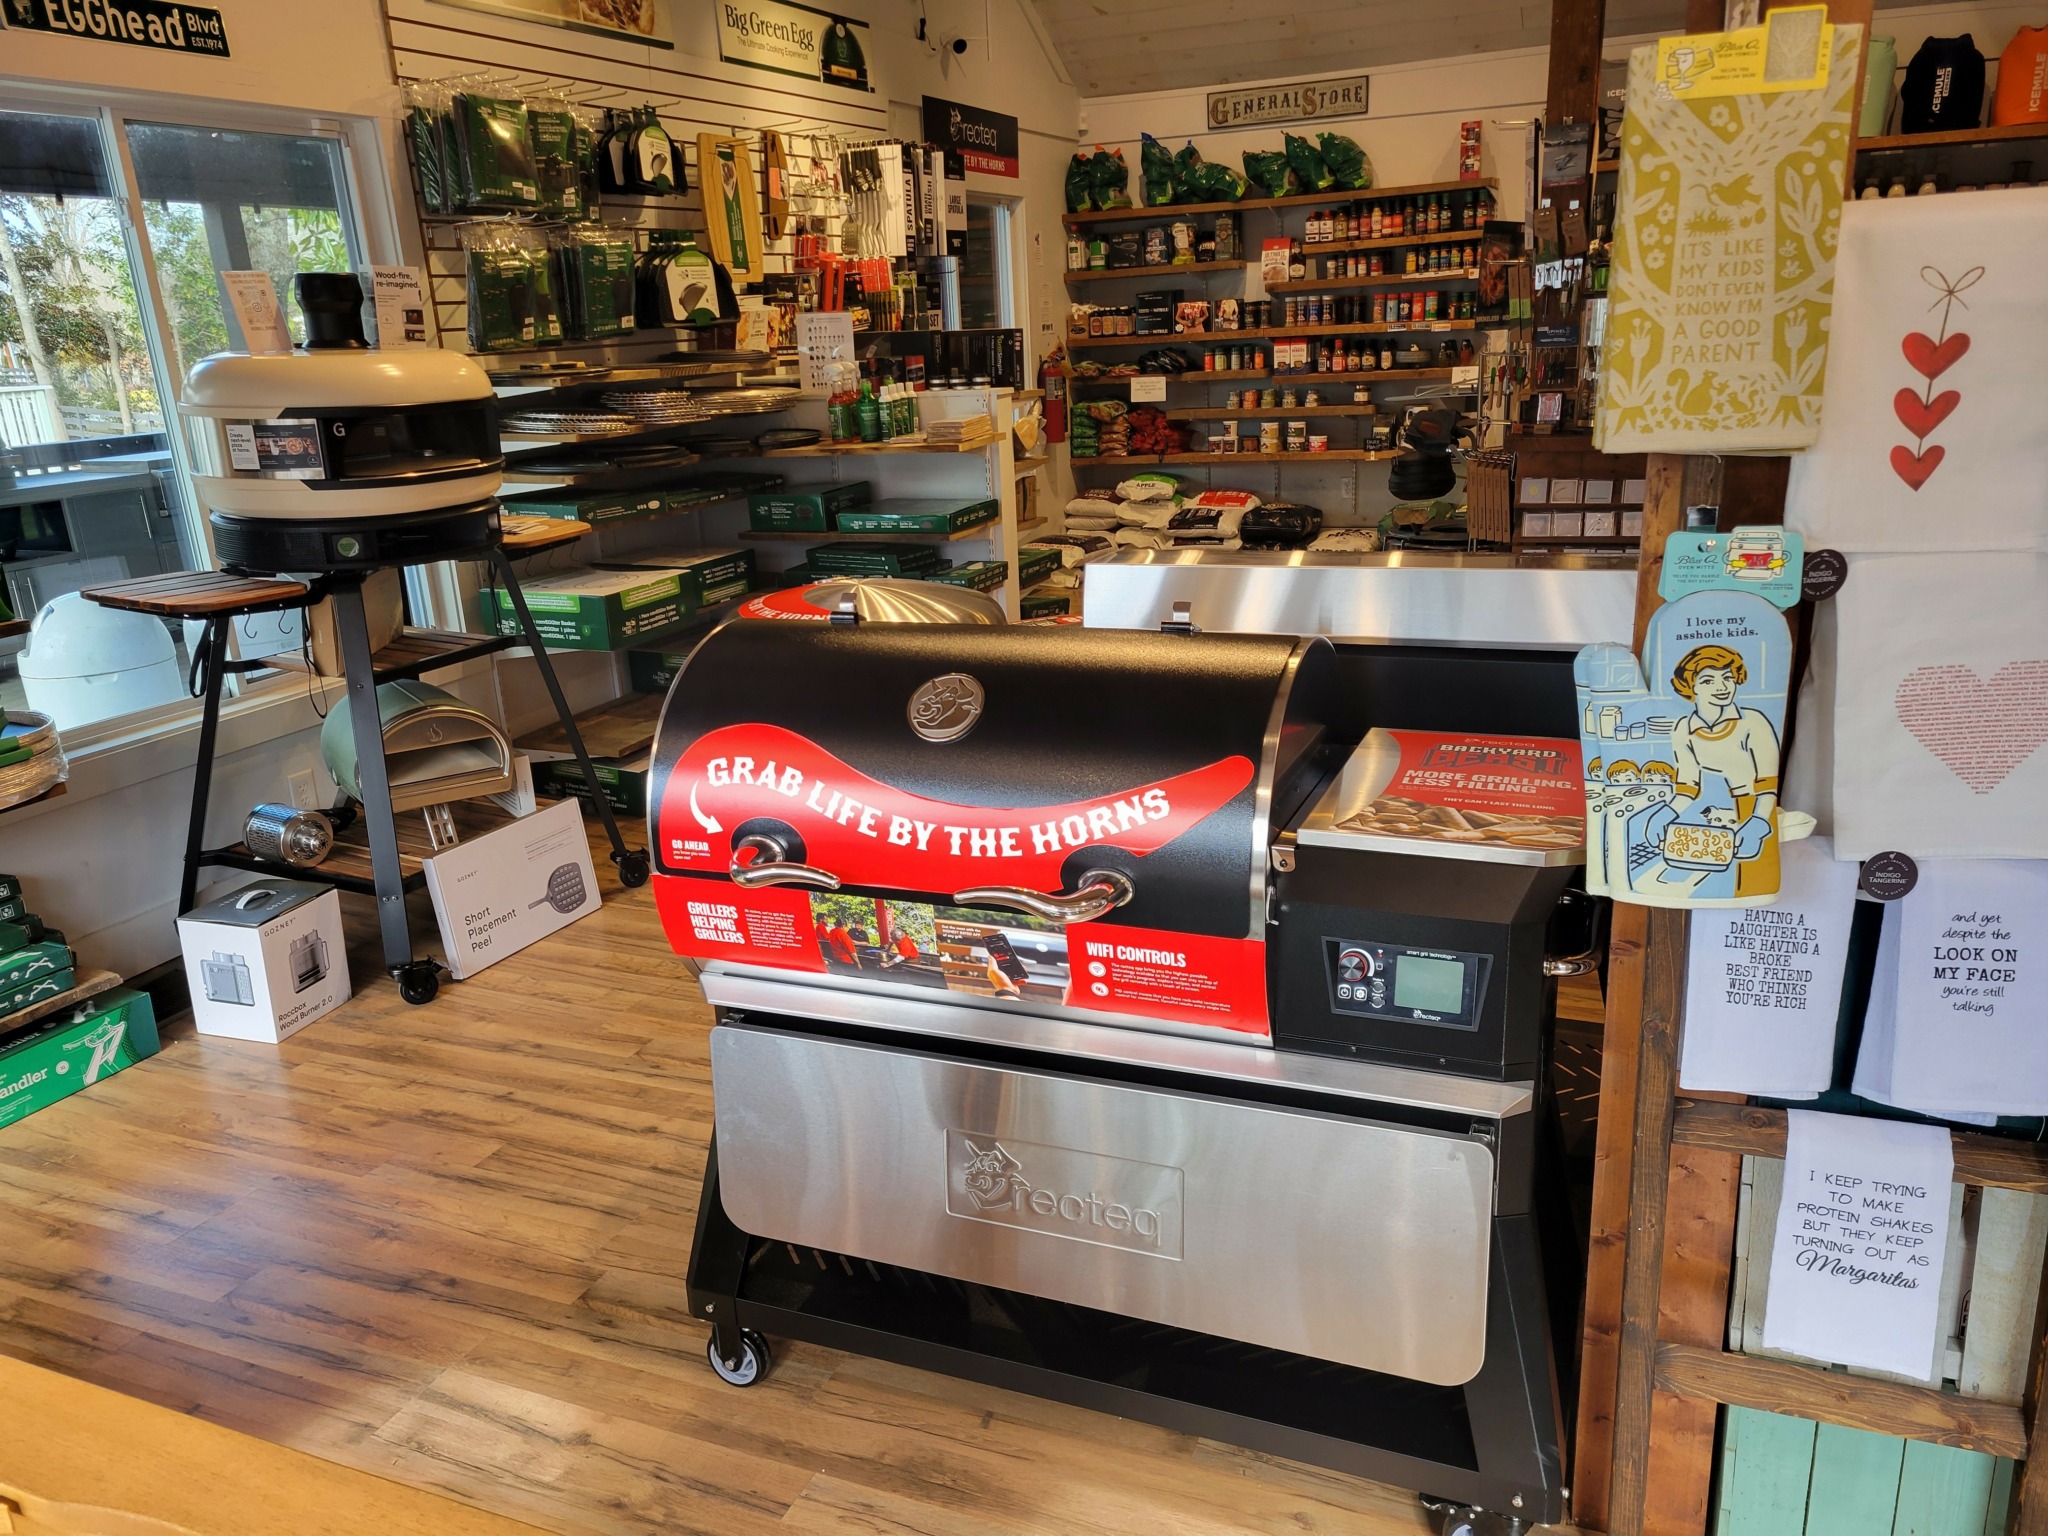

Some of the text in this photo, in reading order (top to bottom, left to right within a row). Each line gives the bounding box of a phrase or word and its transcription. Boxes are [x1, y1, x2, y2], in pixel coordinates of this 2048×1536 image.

[49, 0, 220, 46] EGGhead Blvd
[725, 4, 814, 52] Big Green Egg
[737, 36, 747, 47] The
[748, 39, 765, 51] Ultimate
[766, 43, 784, 57] Cooking
[1932, 67, 1946, 114] ICEMULE
[2029, 53, 2047, 112] ICEMULE
[1210, 85, 1363, 125] GENERAL STORE
[963, 122, 997, 152] recteq
[971, 156, 1005, 172] BY THE HORNS
[906, 178, 914, 231] SPATULA
[949, 195, 961, 205] LARGE
[948, 204, 964, 215] SPATULA
[1681, 238, 1764, 259] IT'S LIKE
[375, 271, 413, 281] Wood-fire,
[1680, 259, 1764, 279] MY KIDS
[375, 280, 421, 291] re-imagined.
[1677, 282, 1765, 298] DON'T EVEN
[1675, 298, 1762, 316] KNOW I'M
[929, 313, 940, 327] SET
[1673, 319, 1760, 340] A GOOD
[1671, 342, 1761, 364] PARENT
[333, 422, 346, 437] G
[1703, 554, 1719, 564] Q
[1803, 576, 1839, 584] TANGERINE
[1686, 617, 1746, 628] I love my
[1675, 627, 1759, 641] asshole kids.
[1440, 744, 1557, 758] BACKYARD
[1481, 739, 1535, 748] recteq
[1405, 770, 1467, 781] MORE
[1402, 777, 1451, 788] LESS
[1456, 781, 1537, 794] FILLING
[706, 756, 1170, 858] GRAB LIFE BY THE HORNS
[672, 839, 711, 852] GO AHEAD,
[1868, 876, 1909, 884] TANGERINE
[464, 906, 491, 926] Short
[687, 901, 738, 919] GRILLERS
[1744, 909, 1805, 926] HAVING A
[1951, 911, 2002, 927] and yet
[264, 917, 295, 938] GOZNEY
[468, 908, 518, 940] Placement
[690, 915, 737, 932] HELPING
[1730, 922, 1817, 941] DAUGHTER IS
[694, 928, 746, 945] GRILLERS
[1942, 927, 2011, 942] despite the
[471, 935, 493, 953] Peel
[1724, 935, 1820, 955] LIKE HAVING A
[1086, 941, 1187, 968] WIFI CONTROLS
[1749, 952, 1792, 967] BROKE
[1933, 946, 2018, 962] LOOK ON
[1726, 963, 1813, 983] BEST FRIEND
[1933, 967, 2016, 982] MY FACE
[1729, 978, 1807, 996] WHO THINKS
[1940, 985, 2005, 999] you're still
[1725, 991, 1807, 1010] YOU'RE RICH
[1952, 1001, 1994, 1017] talking
[278, 1001, 307, 1022] Roccbox
[280, 995, 333, 1031] Wood Burner 2.0
[1810, 1170, 1927, 1198] I KEEP TRYING
[1829, 1191, 1905, 1213] TO MAKE
[1012, 1178, 1162, 1248] recteq
[1797, 1202, 1934, 1234] PROTEIN SHAKES
[1803, 1219, 1924, 1248] BUT THEY KEEP
[1792, 1234, 1930, 1267] TURNING OUT AS
[1796, 1249, 1920, 1289] Margaritas
